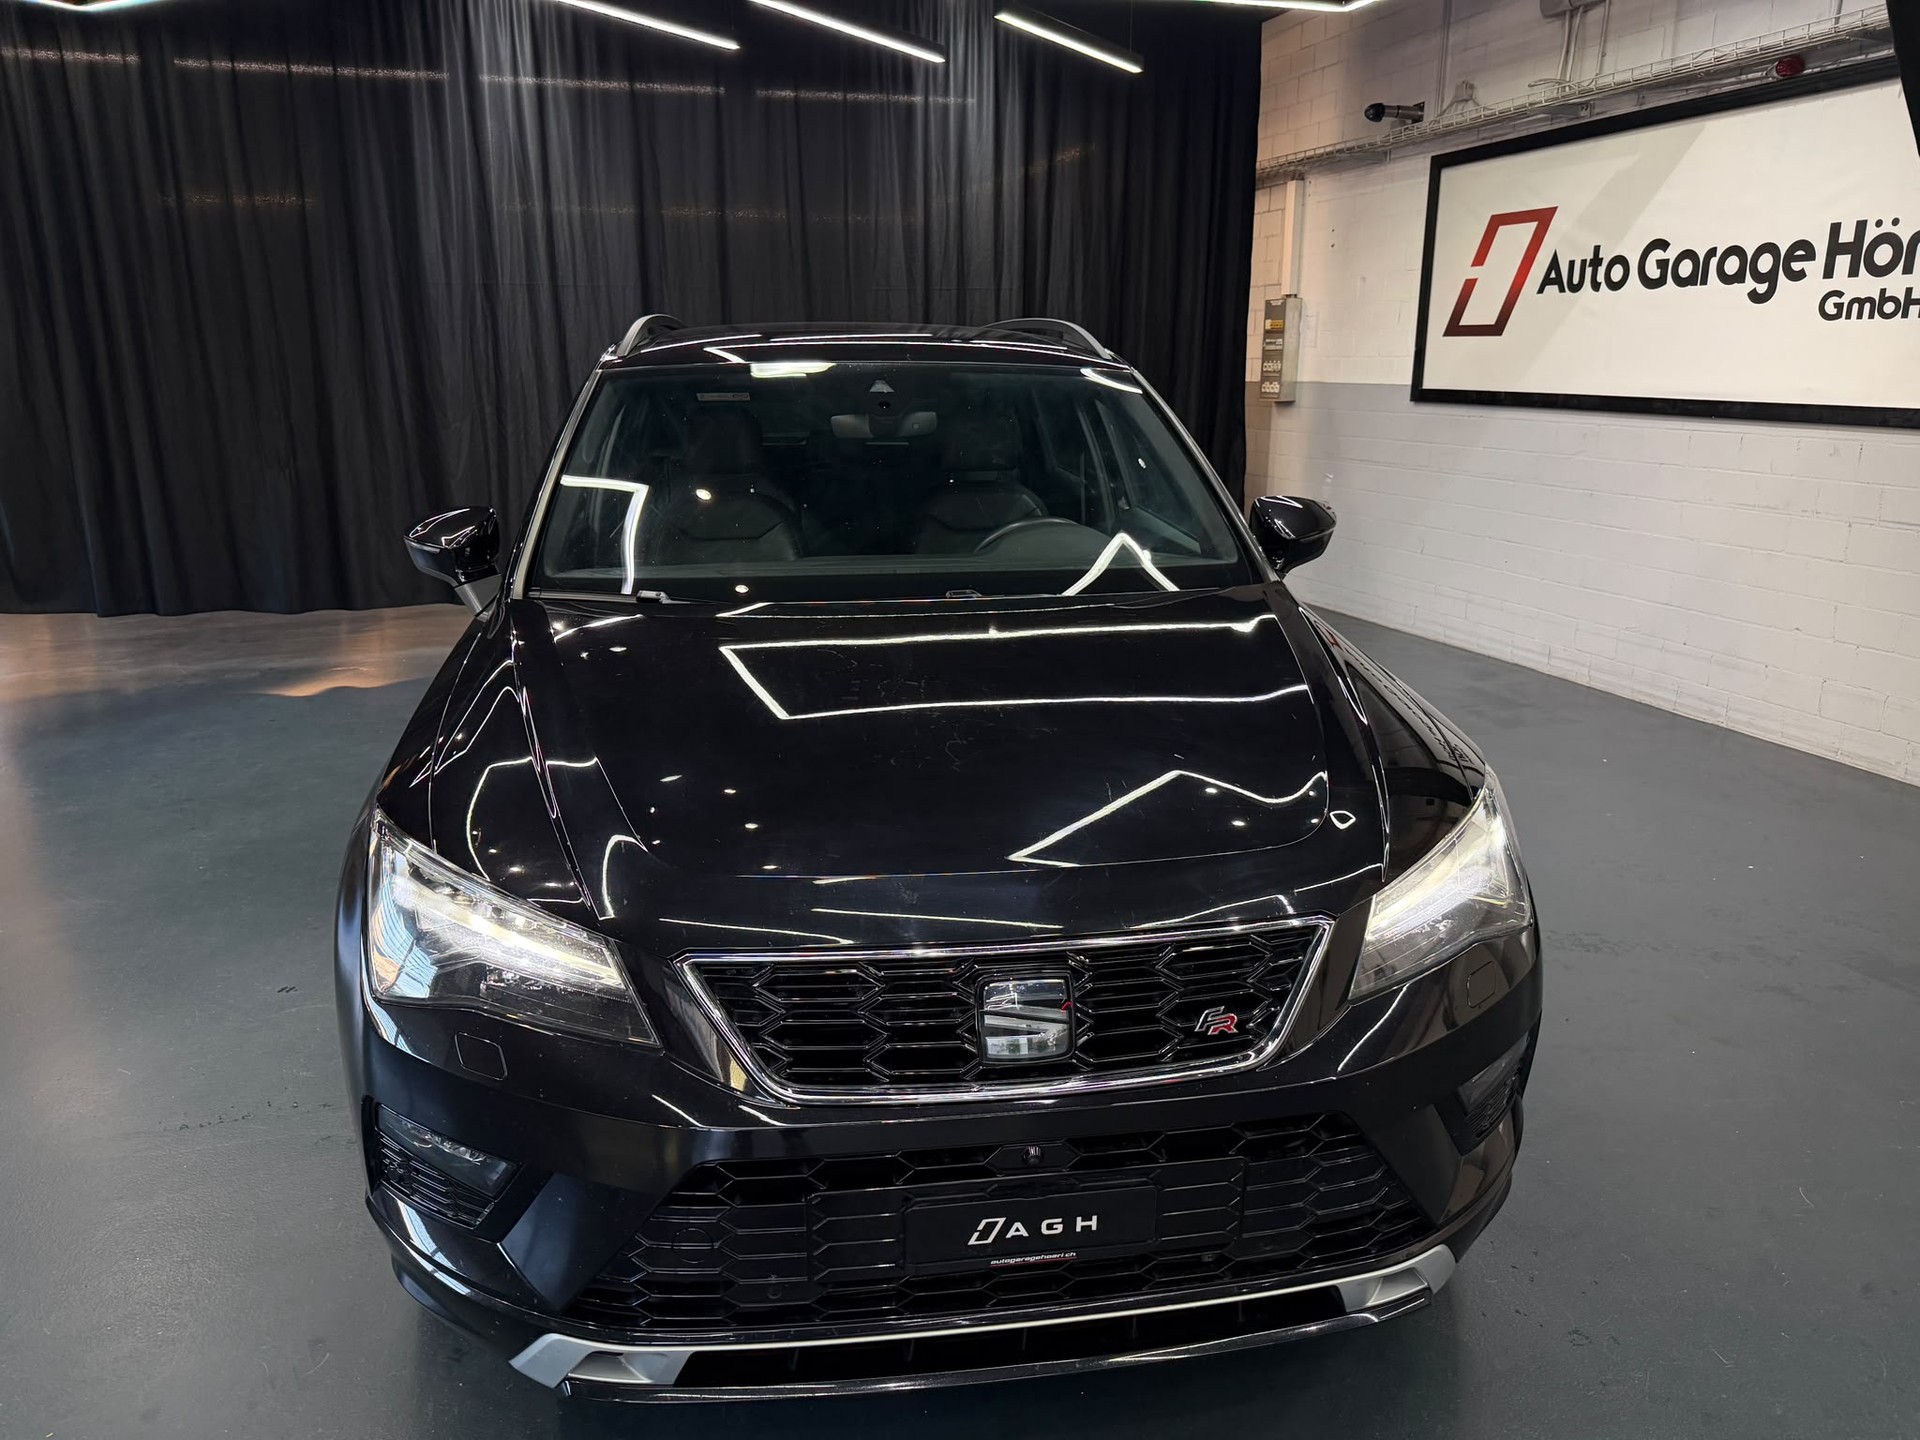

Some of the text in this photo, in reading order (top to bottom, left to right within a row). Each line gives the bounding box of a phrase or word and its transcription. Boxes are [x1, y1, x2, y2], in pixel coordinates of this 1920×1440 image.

[1537, 245, 1630, 294] Auto
[1637, 238, 1816, 304] Garage
[1818, 287, 1920, 321] GmbH
[1194, 1005, 1239, 1035] FR
